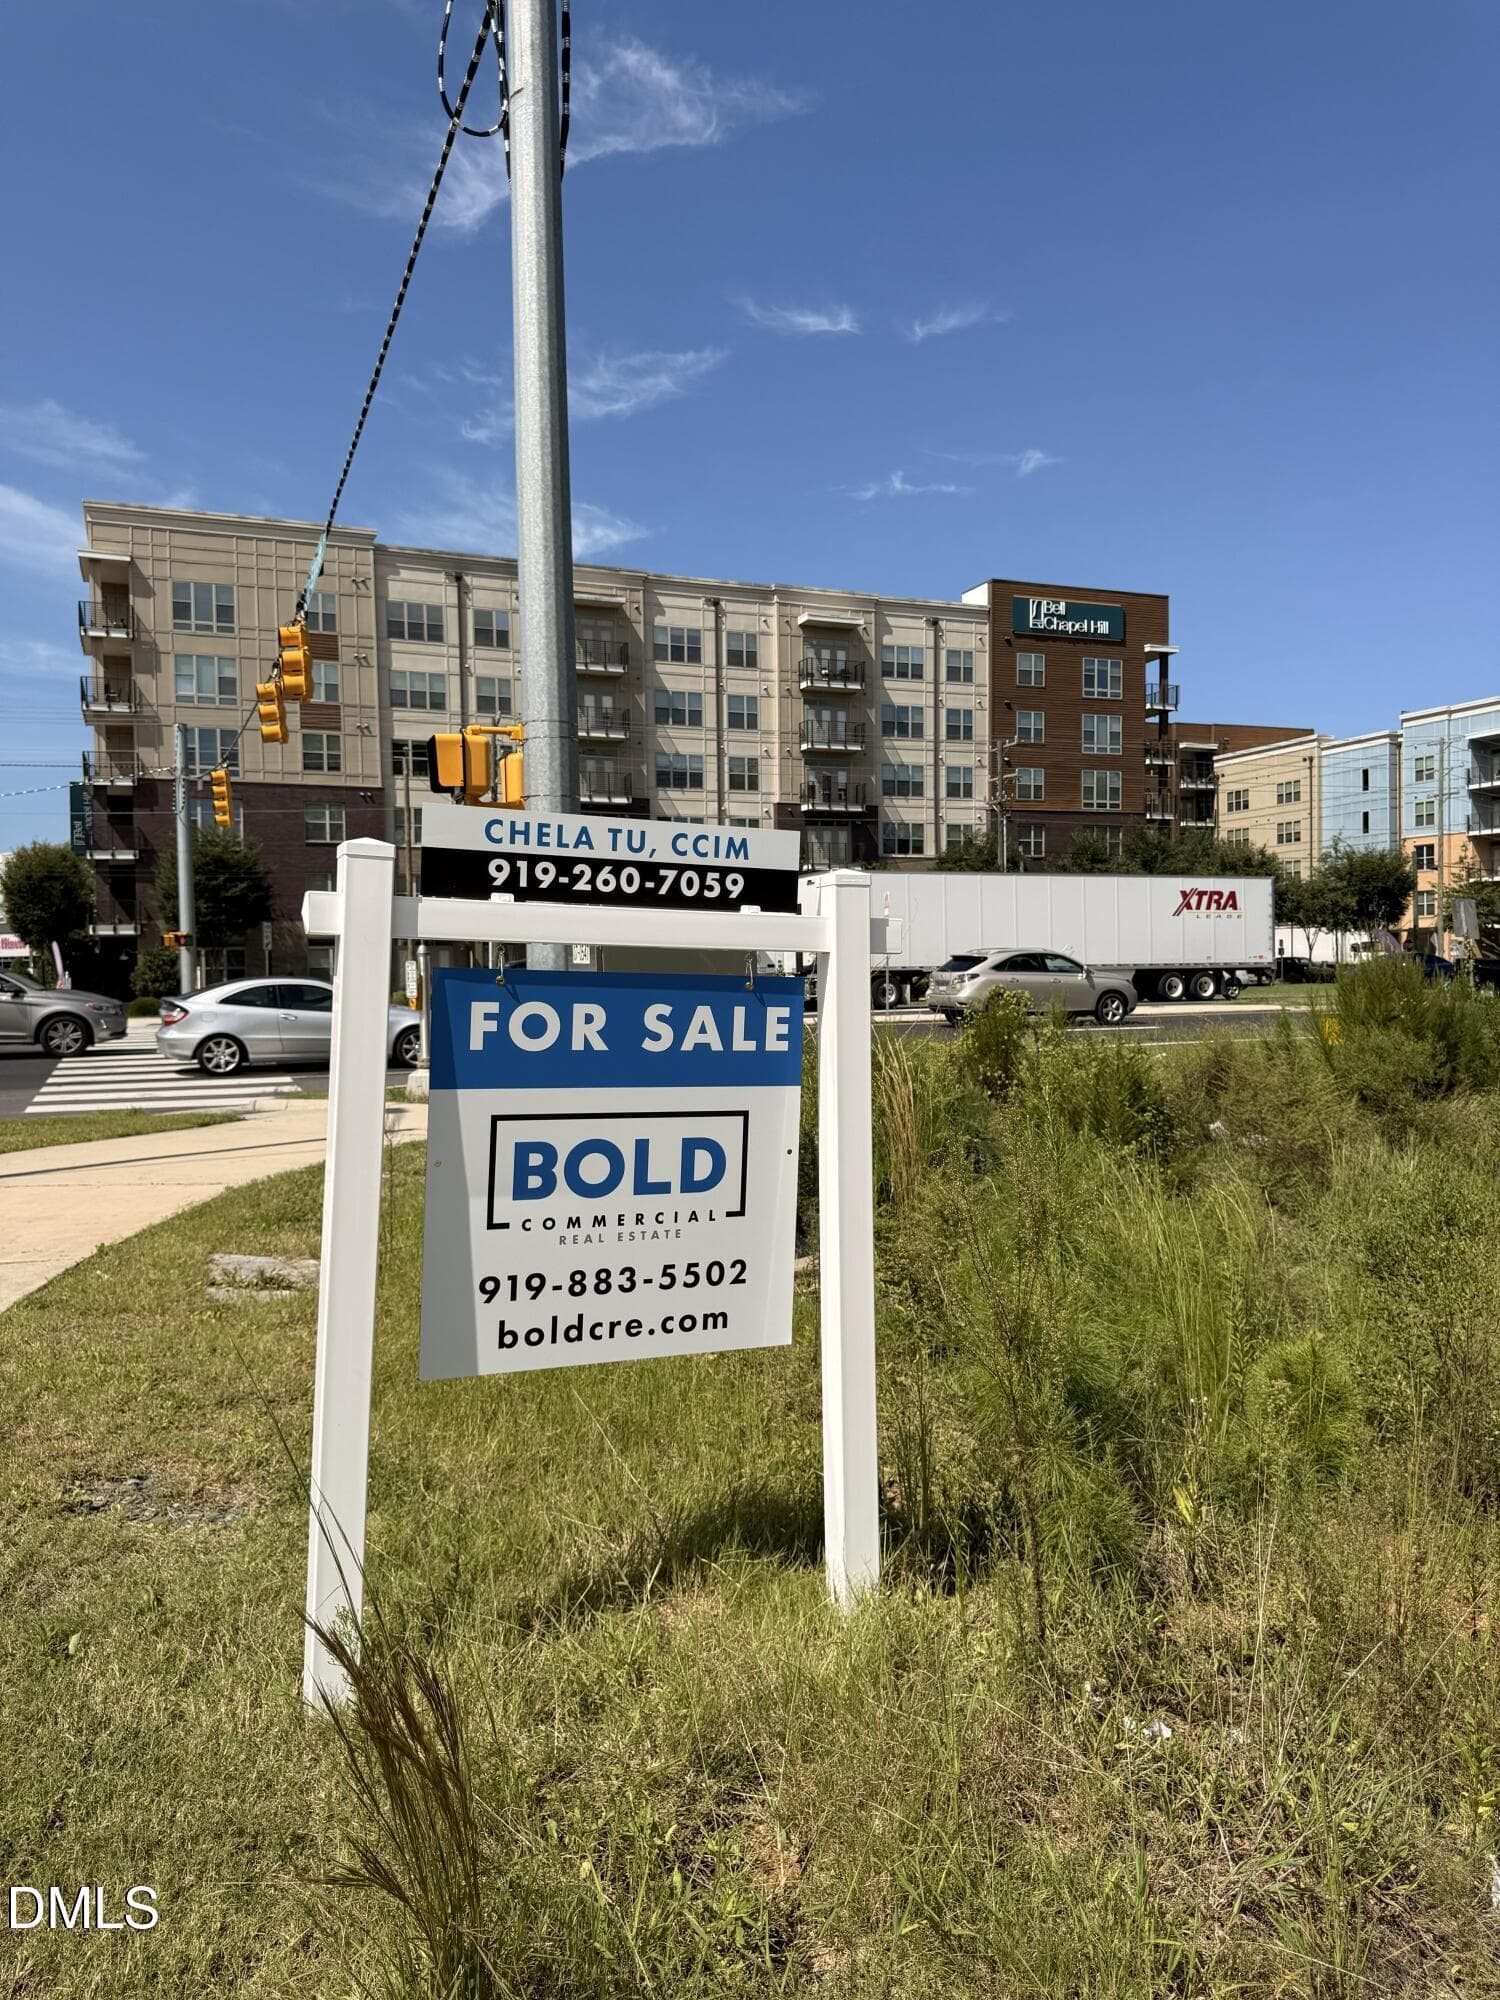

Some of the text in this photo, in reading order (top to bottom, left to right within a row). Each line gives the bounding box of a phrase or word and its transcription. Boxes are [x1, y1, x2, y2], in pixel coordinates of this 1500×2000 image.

[1044, 599, 1066, 615] Bell
[1044, 616, 1109, 634] Chapel Hill
[484, 818, 750, 861] CHELA TU, CCIM
[487, 858, 745, 899] 919-260-7059
[1172, 888, 1238, 916] XTRA
[469, 1001, 790, 1053] FOR SALE
[512, 1137, 727, 1201] BOLD
[521, 1209, 716, 1232] COMMERCIAL
[559, 1229, 683, 1246] REAL ESTATE
[478, 1259, 748, 1304] 919-883-5502
[498, 1311, 729, 1350] boldcre.com
